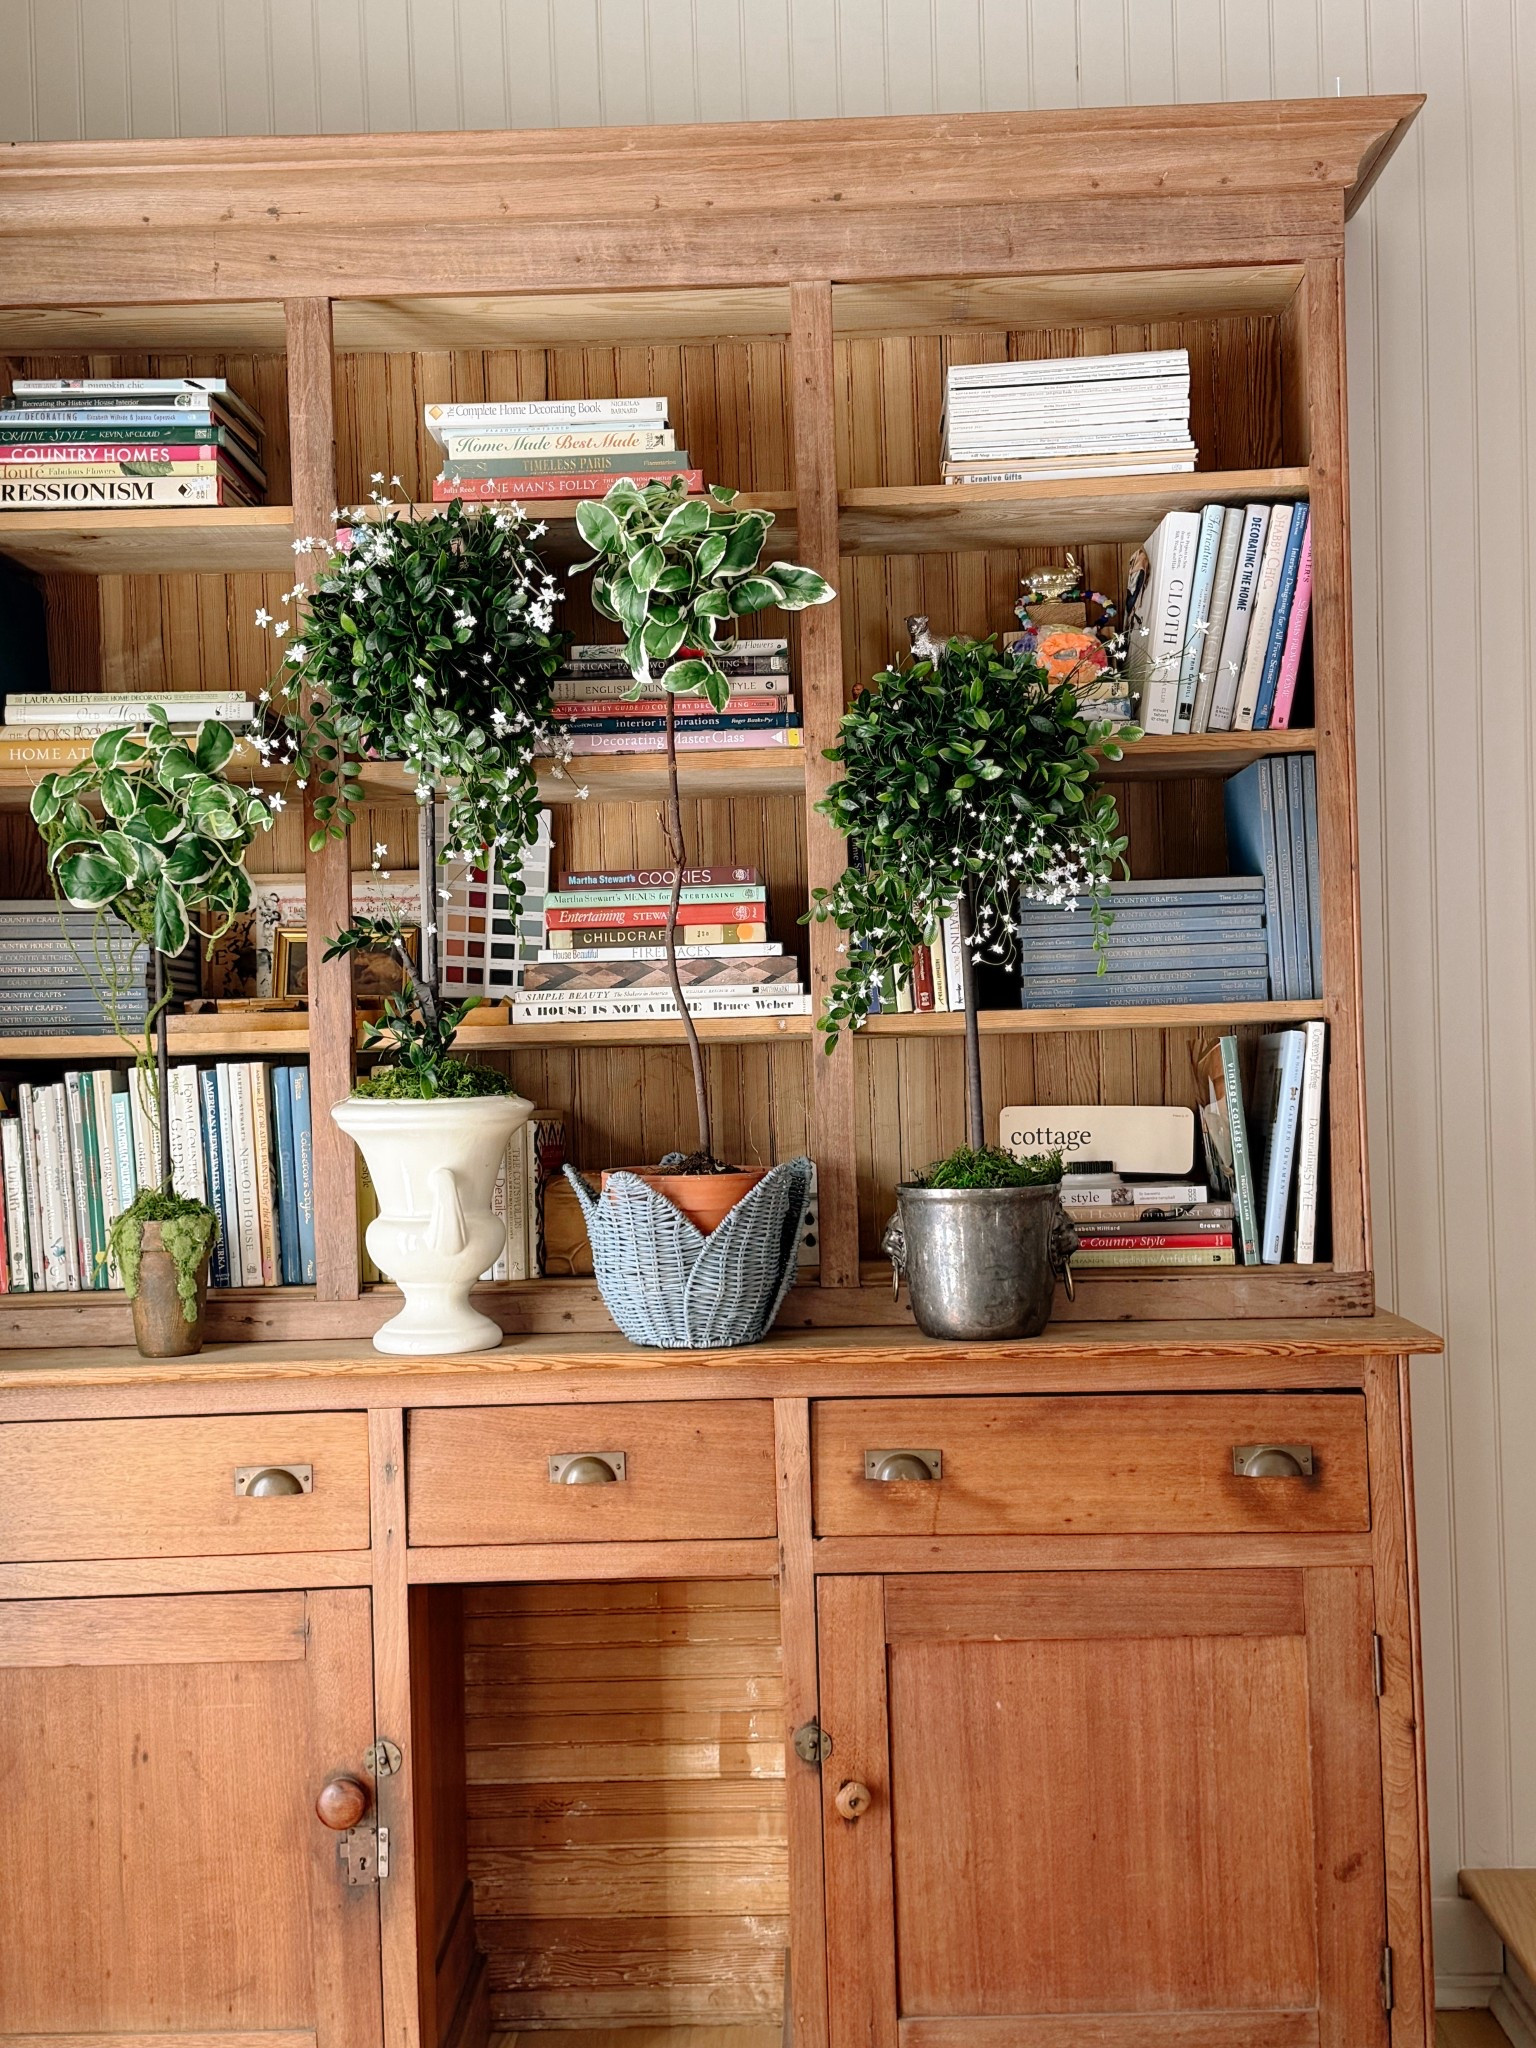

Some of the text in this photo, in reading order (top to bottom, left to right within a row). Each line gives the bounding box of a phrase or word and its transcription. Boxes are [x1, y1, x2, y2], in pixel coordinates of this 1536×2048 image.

[127, 380, 144, 389] chic
[67, 399, 93, 407] Historic
[456, 402, 602, 420] Complete Home Decorating Book
[25, 412, 78, 421] DECORATING
[455, 436, 504, 453] Home
[504, 435, 550, 451] Made
[555, 435, 593, 449] Best
[594, 432, 641, 448] Made
[12, 448, 170, 462] COUNTRY HOMES
[523, 456, 612, 472] TIMELESS PARIS
[970, 472, 1022, 483] Creative Gifts
[480, 479, 599, 494] ONE MAN'S FOLLY
[1270, 513, 1288, 554] SHABBY
[1200, 514, 1220, 573] Fabrications
[1236, 517, 1262, 611] DECORATING THE HOME
[1163, 579, 1184, 645] CLOTH
[1266, 547, 1299, 684] Interior Designing for All Five Senses
[585, 686, 630, 695] ENGLISH
[24, 696, 55, 704] LAURA
[56, 696, 94, 704] ASHLEY
[130, 694, 172, 702] DECORATING
[651, 702, 692, 710] COUTRY
[616, 717, 720, 728] interior inpirations
[28, 728, 71, 741] COOK'S
[591, 732, 745, 750] Decorating Class
[10, 747, 90, 761] HOME AT
[568, 876, 597, 886] Martha
[600, 874, 636, 884] Stewart's
[1266, 855, 1276, 913] COUNTRY STYLE
[554, 892, 670, 904] Martha Stewart's MENUS for
[1114, 896, 1148, 904] COUNTRY
[558, 910, 681, 924] Entertaining STEWAT
[583, 930, 668, 944] CHILDCRAF
[1112, 936, 1126, 944] THE
[1165, 934, 1186, 942] HOME
[552, 950, 599, 960] House Beautiful
[1108, 950, 1142, 958] COUNTRY
[526, 991, 611, 1001] SIMPLE BEAUTY
[1109, 985, 1160, 994] THE COUNTRY
[522, 1008, 532, 1016] A
[538, 1006, 587, 1016] HOUSE
[592, 1006, 607, 1014] IS
[612, 1004, 641, 1014] NOT
[646, 1004, 654, 1013] A
[714, 1001, 751, 1012] Bruce
[756, 1000, 794, 1010] Weber
[1110, 997, 1188, 1006] COUNTRY FURNITURE
[1307, 1029, 1322, 1064] Country
[208, 1080, 216, 1126] AMERICAN
[1226, 1062, 1243, 1154] vintage cottages
[183, 1083, 198, 1180] FORMAL COUNTRY
[1011, 1128, 1092, 1151] cottage
[171, 1118, 185, 1185] GARDEN
[1279, 1105, 1296, 1196] GARDEN ORNAMENT
[239, 1148, 249, 1177] NEW
[257, 1098, 265, 1153] DECORATIVE
[263, 1220, 271, 1240] Home
[1302, 1118, 1318, 1210] Decorating STYLE
[73, 1148, 87, 1213] easy decor
[103, 1146, 116, 1207] cottage style
[299, 1132, 313, 1224] Collector's Style
[242, 1180, 252, 1204] OLD
[494, 1178, 505, 1216] Details
[512, 1148, 522, 1230] THE COTSWOLDS
[1071, 1191, 1100, 1204] style
[1090, 1207, 1203, 1219] HOME PAST
[244, 1209, 254, 1252] HOUSE
[1090, 1236, 1166, 1248] Country Style
[1114, 1254, 1202, 1266] Leading Artful Life
